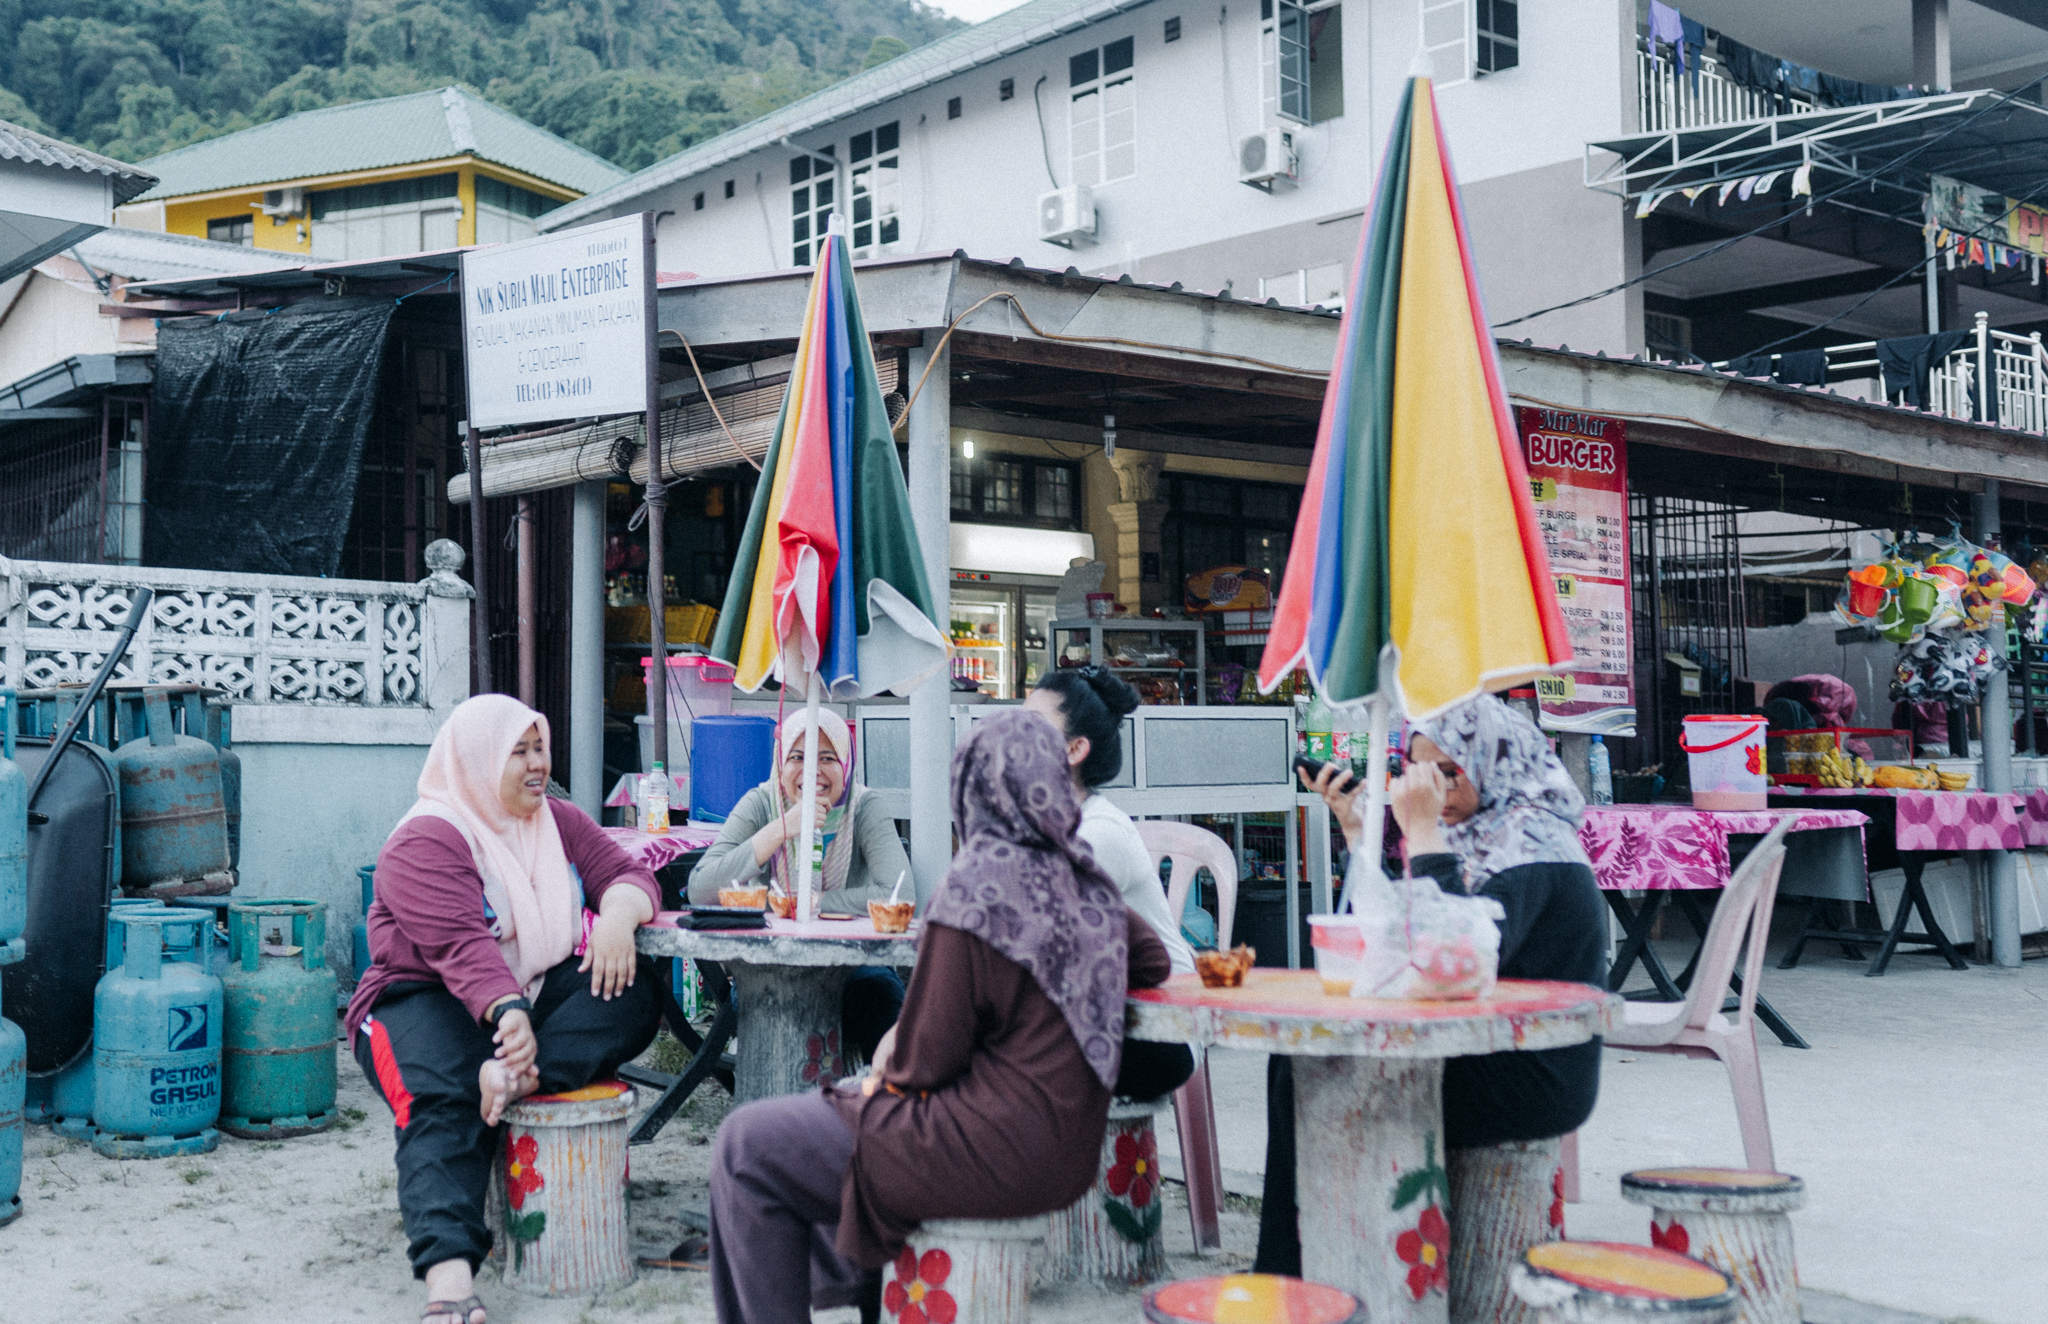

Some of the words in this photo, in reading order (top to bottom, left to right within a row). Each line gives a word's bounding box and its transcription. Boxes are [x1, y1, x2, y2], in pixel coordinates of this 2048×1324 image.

[476, 286, 494, 315] NIK
[497, 280, 527, 312] SURIA
[530, 273, 557, 305] MAJU
[561, 258, 628, 300] ENTERPRISE
[1529, 434, 1615, 474] BURGER
[151, 1064, 217, 1086] PETRON
[151, 1081, 217, 1105] GASUL
[150, 1107, 173, 1117] NET
